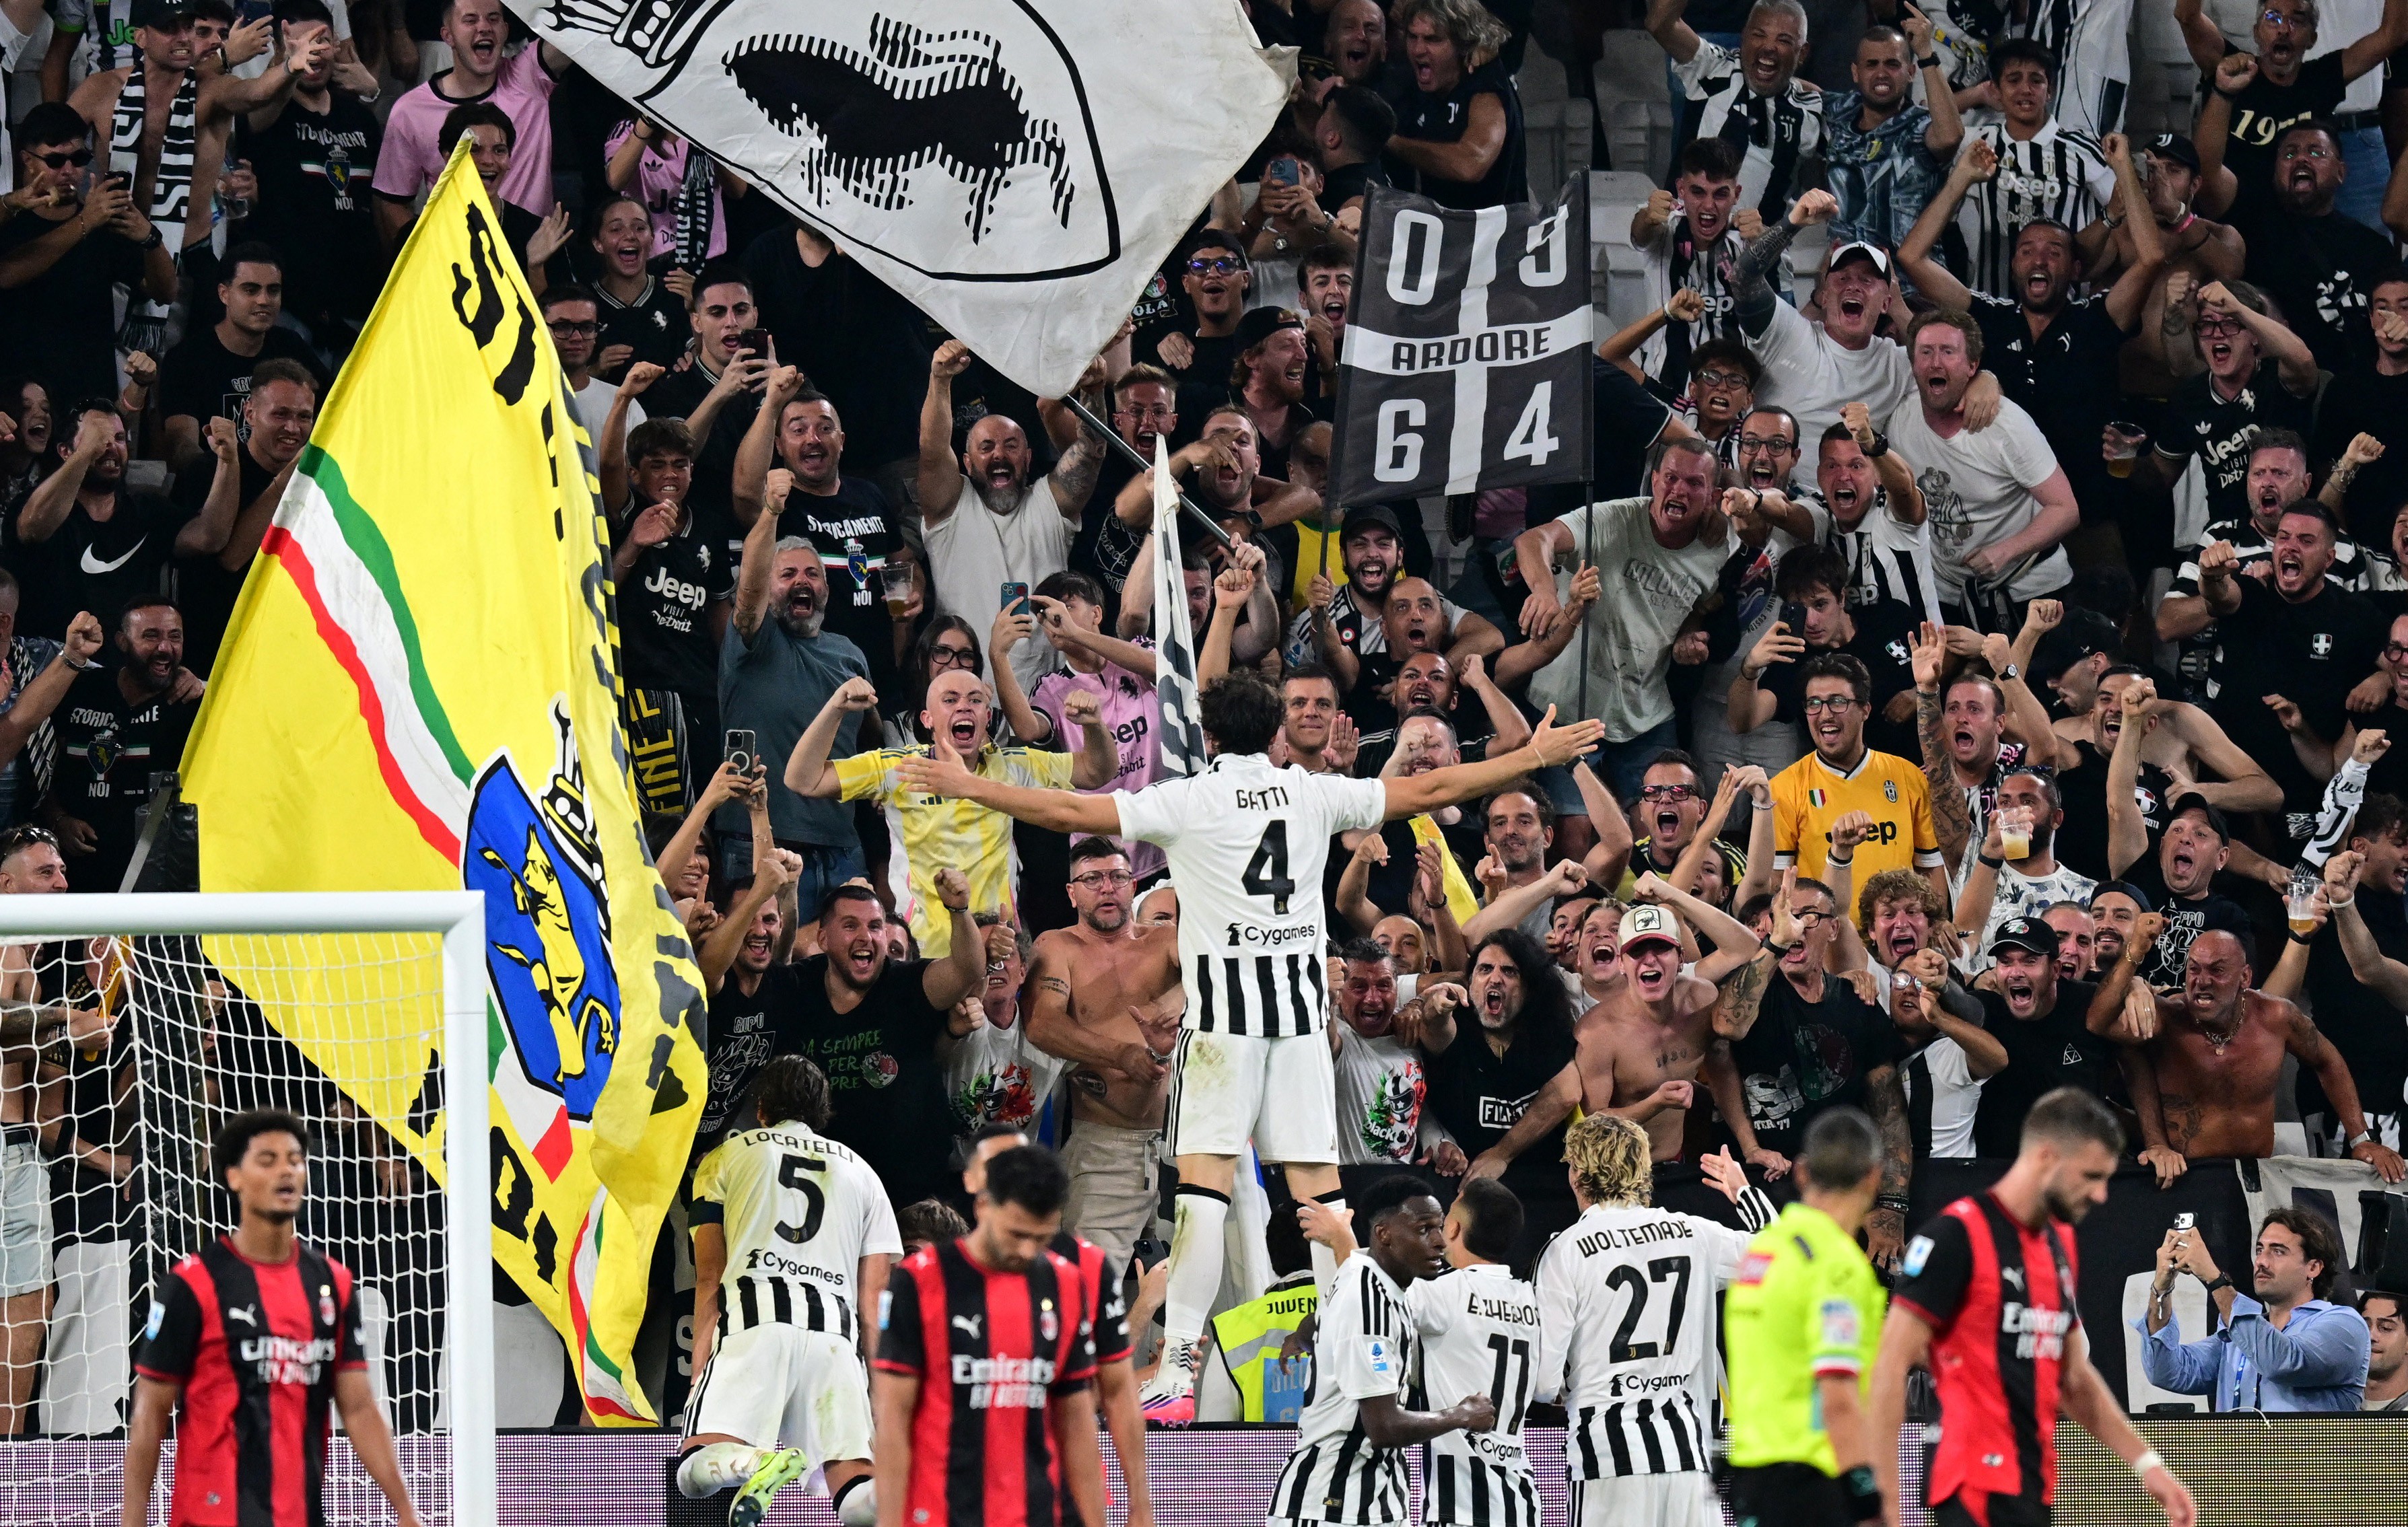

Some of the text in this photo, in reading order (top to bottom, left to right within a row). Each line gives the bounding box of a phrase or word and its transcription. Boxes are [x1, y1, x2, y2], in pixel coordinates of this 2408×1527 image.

[335, 197, 354, 211] NOI
[1386, 209, 1443, 306] 0
[1132, 299, 1168, 316] OLA
[1702, 296, 1735, 318] ep
[1391, 326, 1551, 371] ARDORE
[1373, 380, 1559, 483] 6 4
[2223, 454, 2248, 470] VISIT
[807, 514, 887, 540] STRICAMENTE
[644, 566, 706, 611] Jeep
[853, 590, 872, 606] NOI
[663, 603, 687, 618] VISIT
[1110, 715, 1148, 744] ep
[88, 781, 110, 798] NOI
[1236, 786, 1289, 811] GATTI
[1241, 819, 1295, 915] 4
[1245, 925, 1315, 946] Cygames
[821, 1029, 883, 1055] SEMPRE
[828, 1055, 860, 1073] PER
[829, 1076, 862, 1090] PRE
[1777, 1117, 1791, 1131] 77
[744, 1131, 854, 1164] LOCATELLI
[774, 1153, 827, 1244] 5
[1576, 1220, 1694, 1258] WOLTEMADE
[763, 1251, 845, 1285] Cygames
[1266, 1296, 1317, 1315] JUVEN
[1605, 1255, 1692, 1364] 27
[1486, 1333, 1529, 1436] 11
[1626, 1373, 1690, 1393] Cygam
[1480, 1437, 1523, 1462] Cygam
